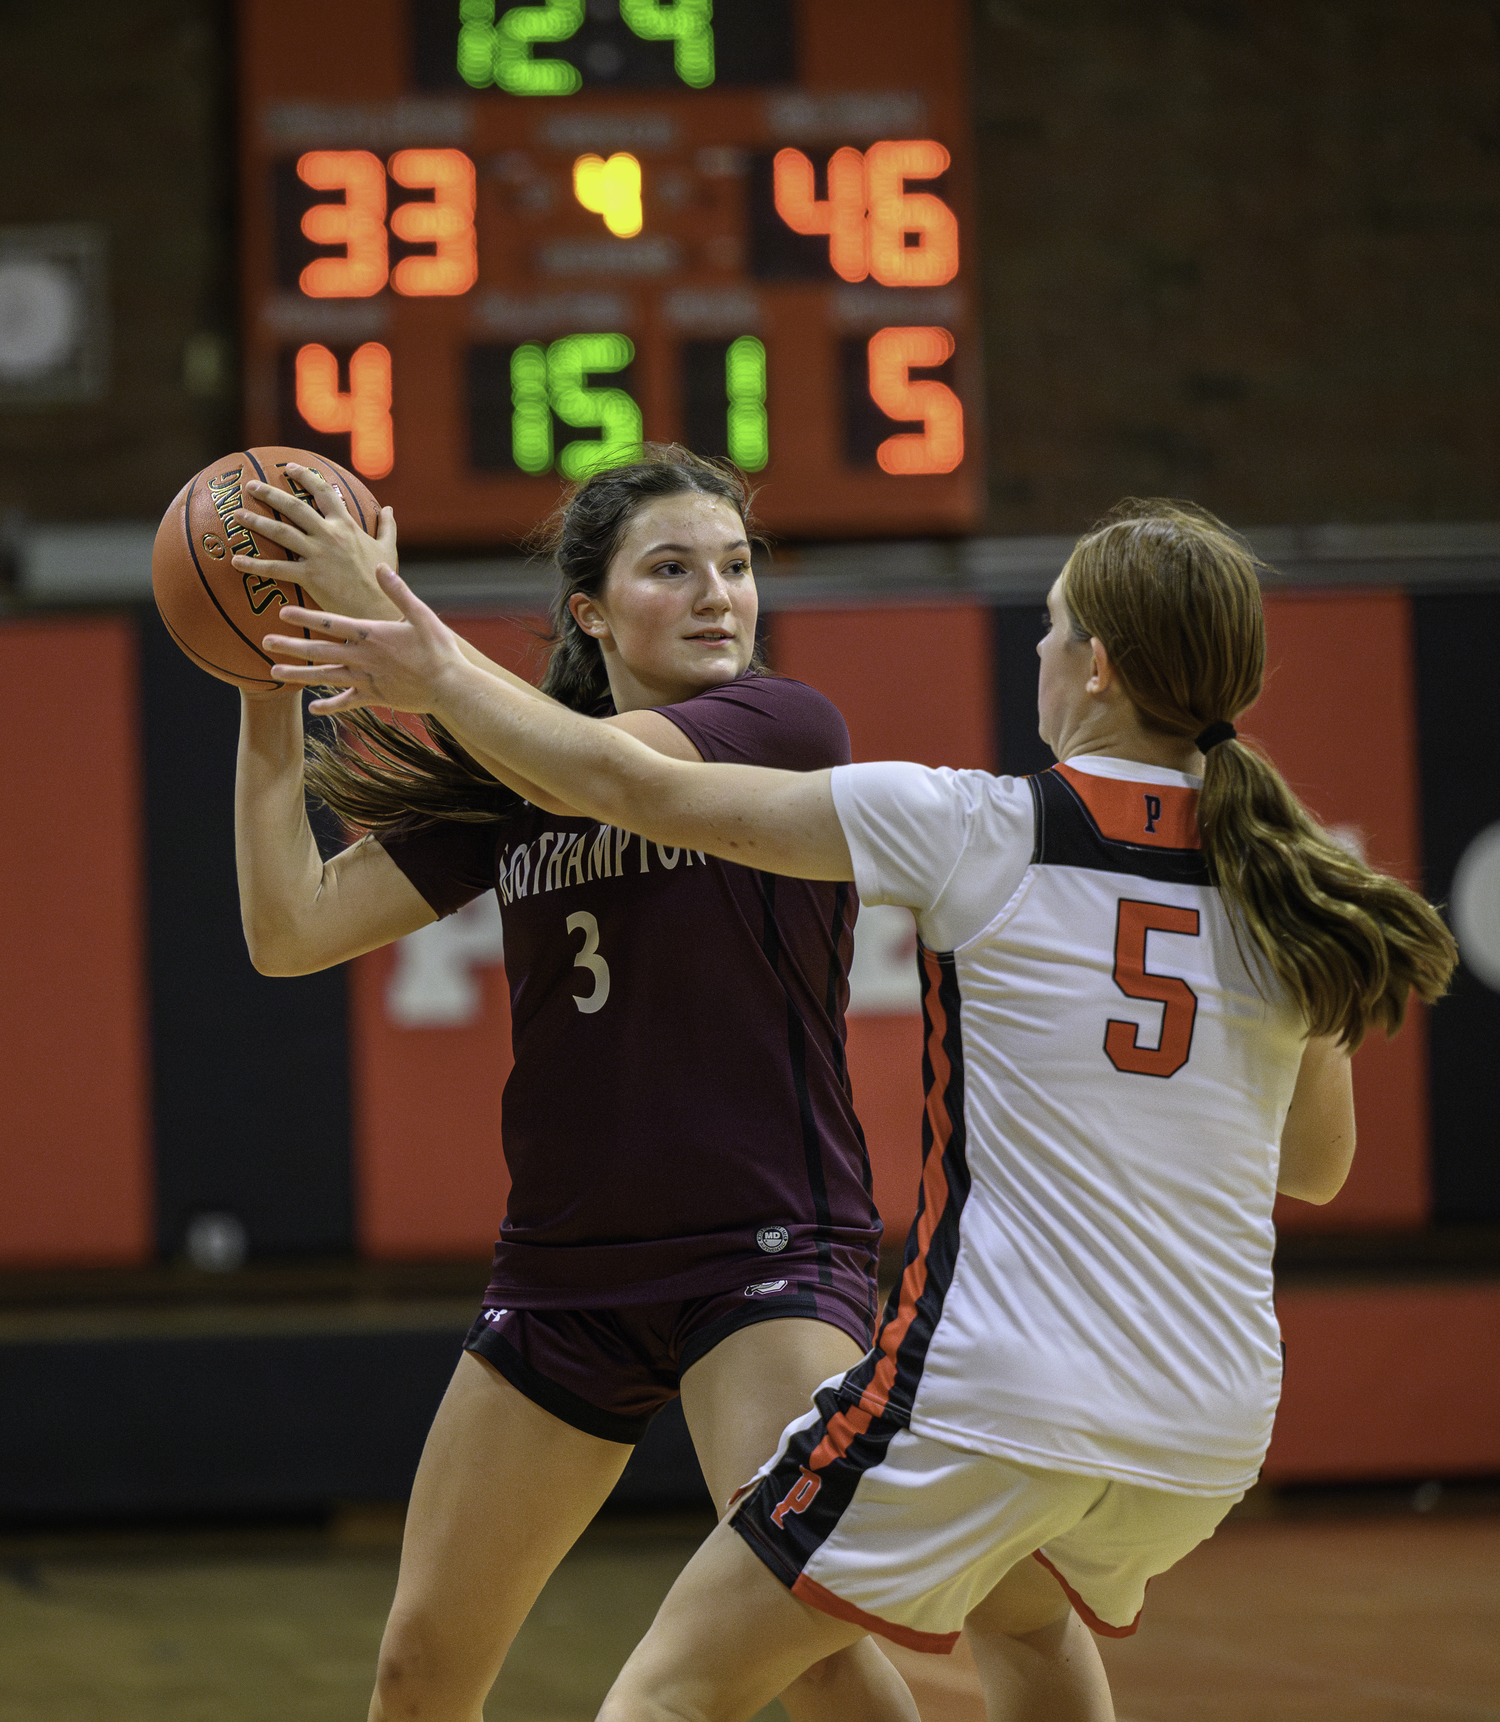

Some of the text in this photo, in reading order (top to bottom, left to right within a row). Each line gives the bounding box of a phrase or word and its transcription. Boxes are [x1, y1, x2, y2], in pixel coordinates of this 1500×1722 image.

[296, 148, 478, 298] 33
[573, 152, 643, 238] 4
[773, 139, 959, 287] 46
[295, 342, 394, 480] 4
[511, 332, 643, 481] 15
[726, 334, 768, 472] 1
[868, 325, 965, 475] 5
[1144, 794, 1161, 833] P
[566, 911, 610, 1013] 3
[1103, 898, 1200, 1078] 5
[764, 1231, 781, 1239] MD
[770, 1465, 822, 1529] P
